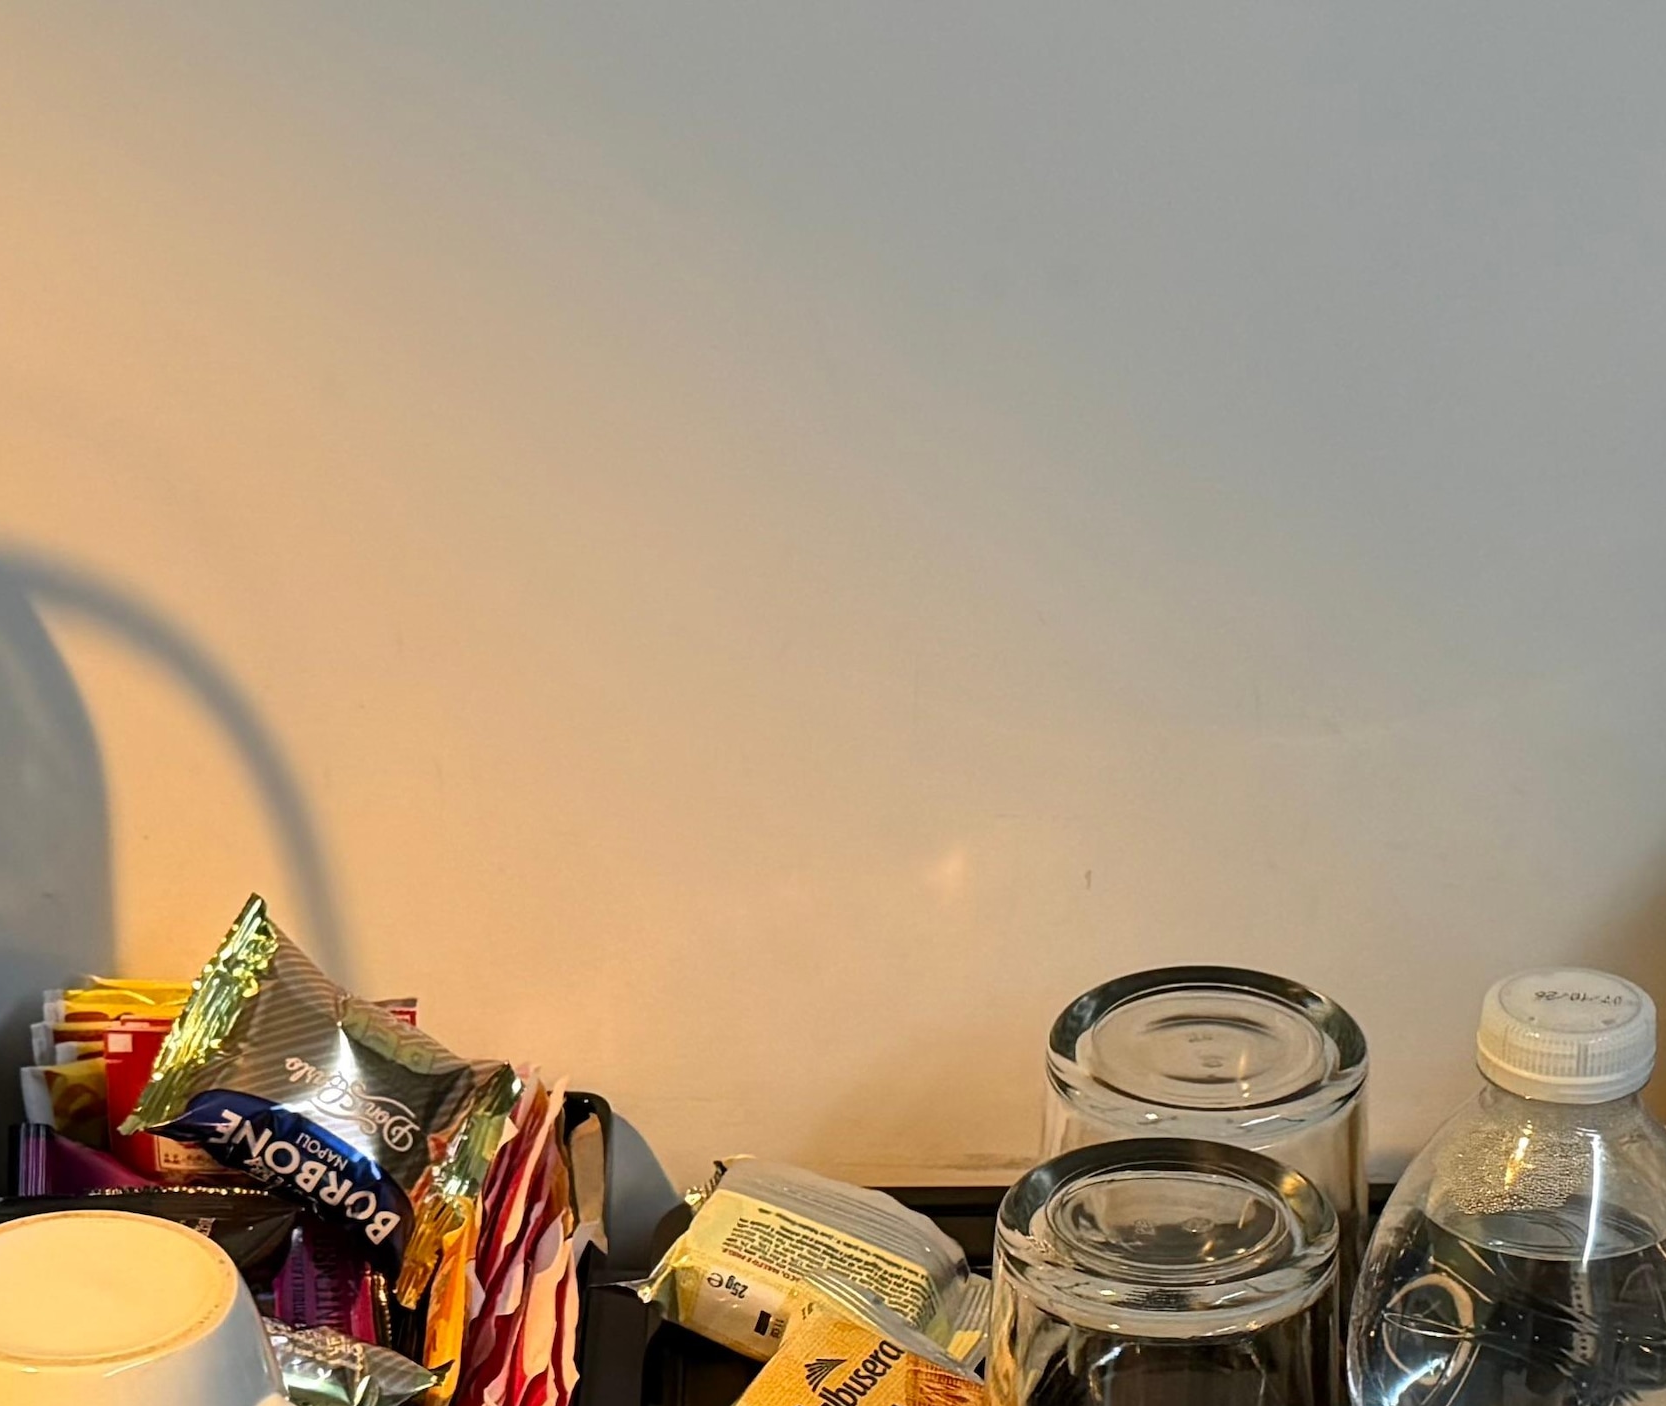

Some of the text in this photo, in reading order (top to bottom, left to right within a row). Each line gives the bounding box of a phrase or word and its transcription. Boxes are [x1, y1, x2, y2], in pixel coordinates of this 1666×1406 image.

[296, 1132, 348, 1171] NAPOLI
[208, 1108, 401, 1245] BORBONE
[725, 1275, 749, 1299] 25g
